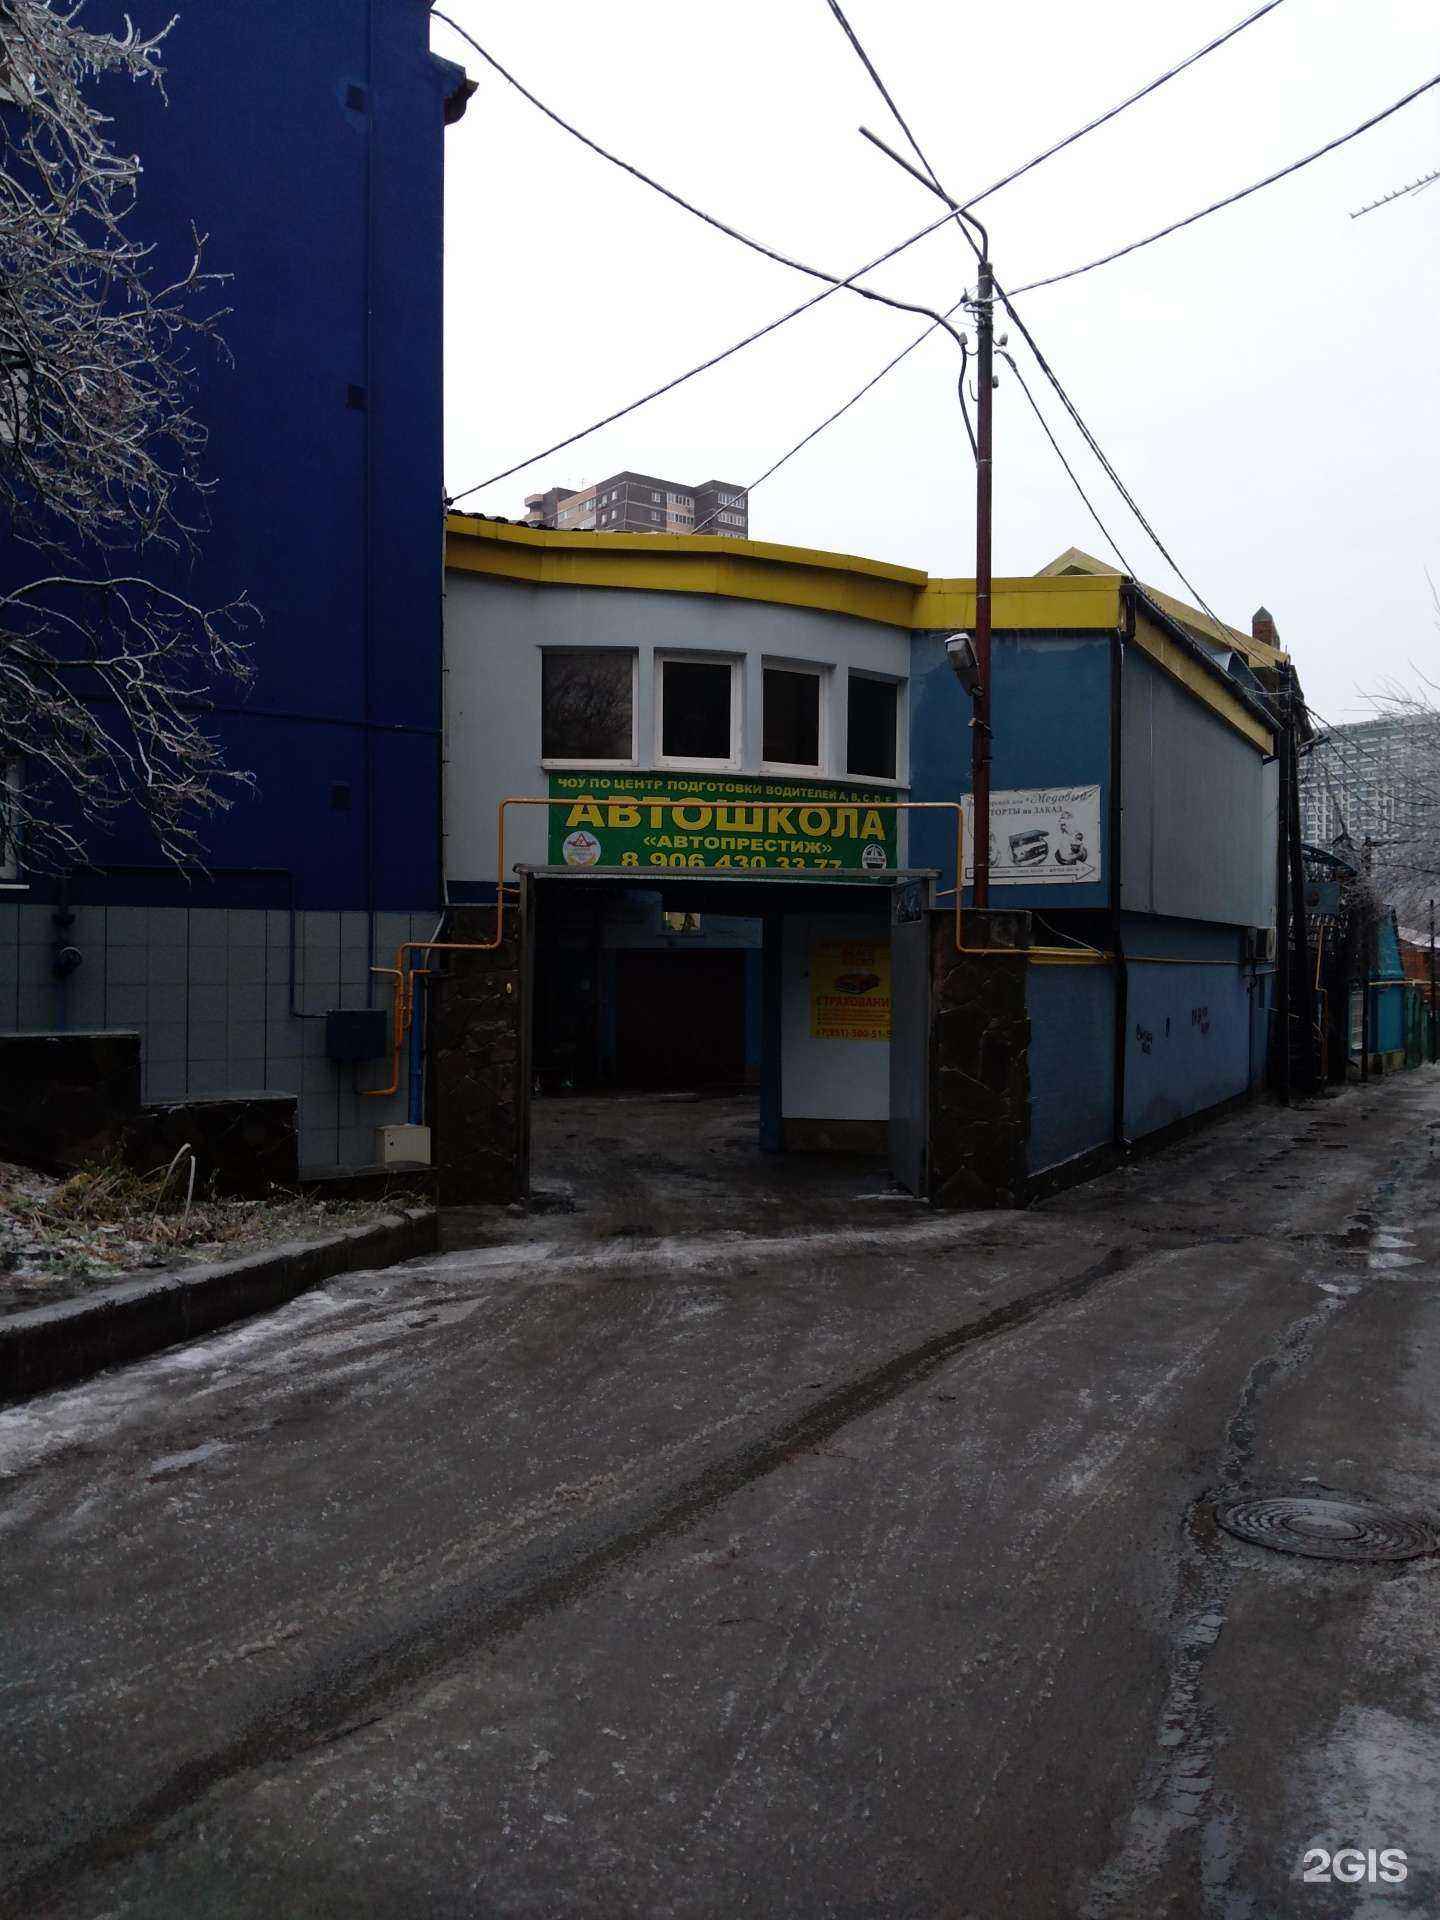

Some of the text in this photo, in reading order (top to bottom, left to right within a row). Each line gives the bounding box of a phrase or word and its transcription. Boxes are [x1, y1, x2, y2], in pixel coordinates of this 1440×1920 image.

[558, 778, 586, 790] ЧОУ
[589, 778, 610, 789] ПО
[614, 779, 663, 790] ЦЕНТР
[667, 780, 761, 794] ПОДГОТОВКИ
[766, 786, 836, 800] ВОДИТЕЛЕЙ
[565, 795, 886, 840] АВТОШКОЛА
[644, 835, 832, 853] «АВТОПРЕСТИЖ»
[620, 852, 843, 871] 8 906 430 33 77
[816, 996, 890, 1008] СТРАХОВАНИ
